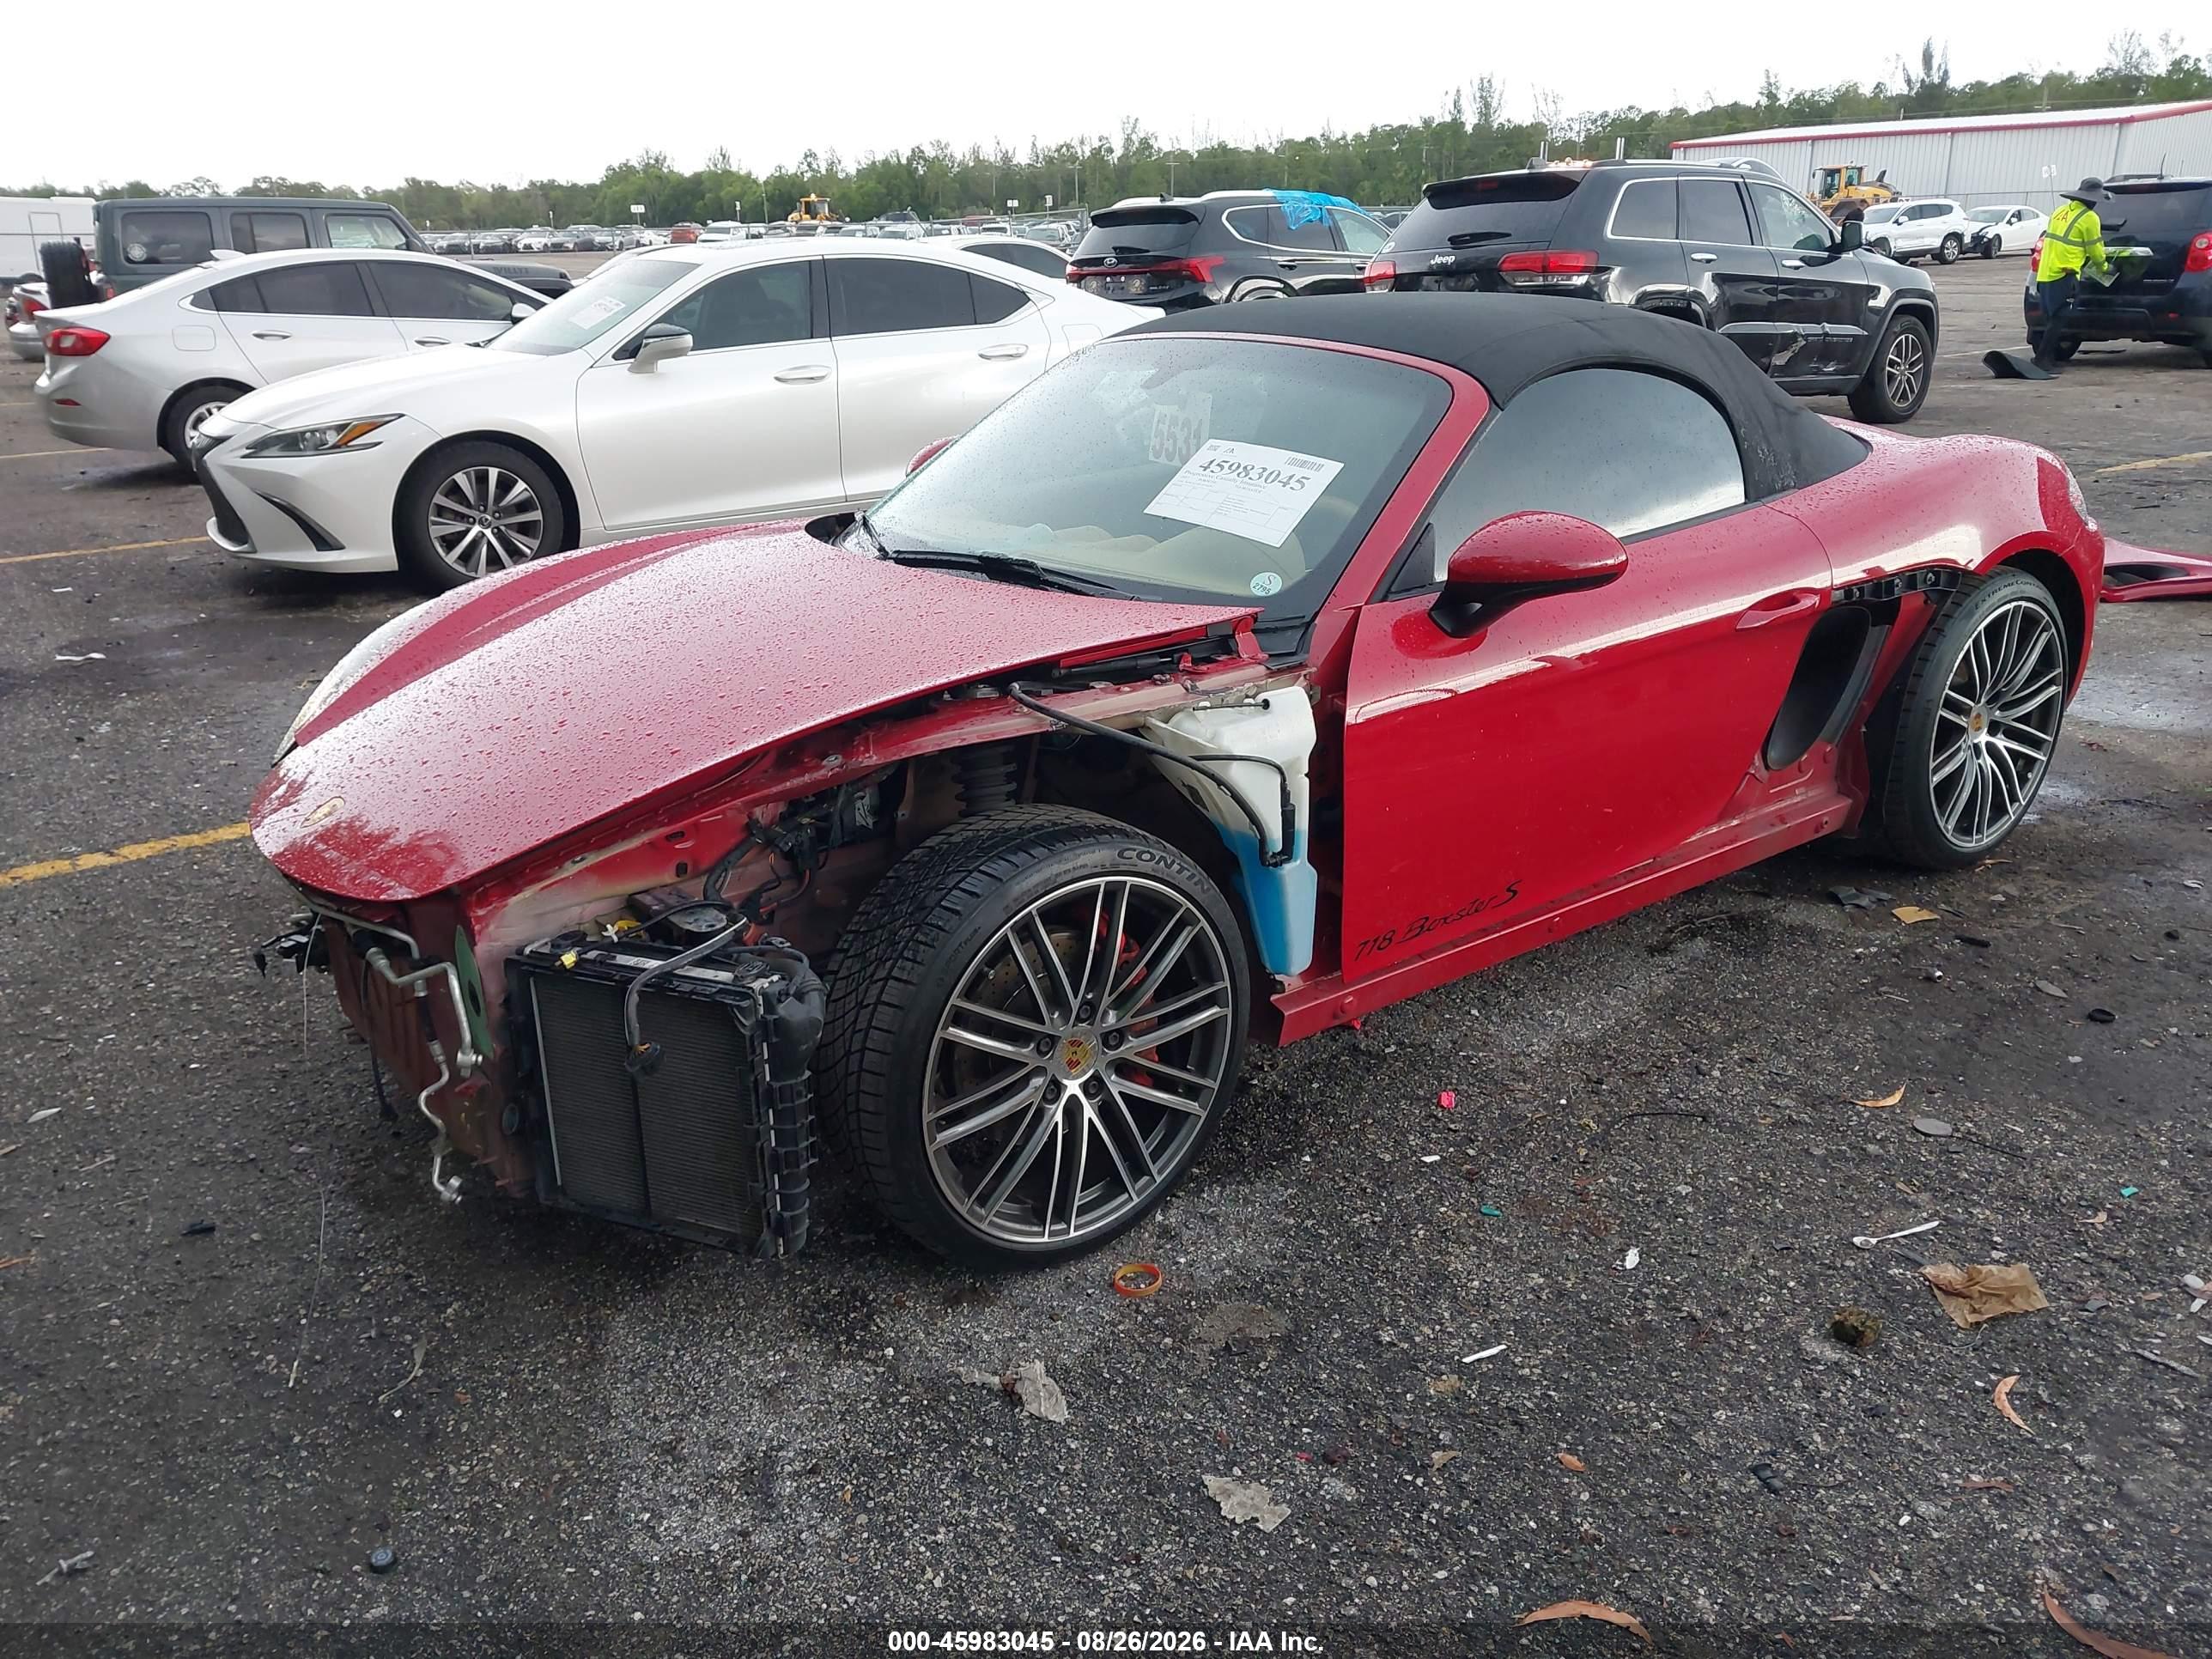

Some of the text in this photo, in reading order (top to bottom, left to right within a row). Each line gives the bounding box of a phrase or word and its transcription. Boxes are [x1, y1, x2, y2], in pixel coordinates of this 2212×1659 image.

[1430, 254, 1455, 265] Jeep
[1199, 459, 1312, 492] 45983045
[1354, 879, 1522, 962] 718 Boxster S
